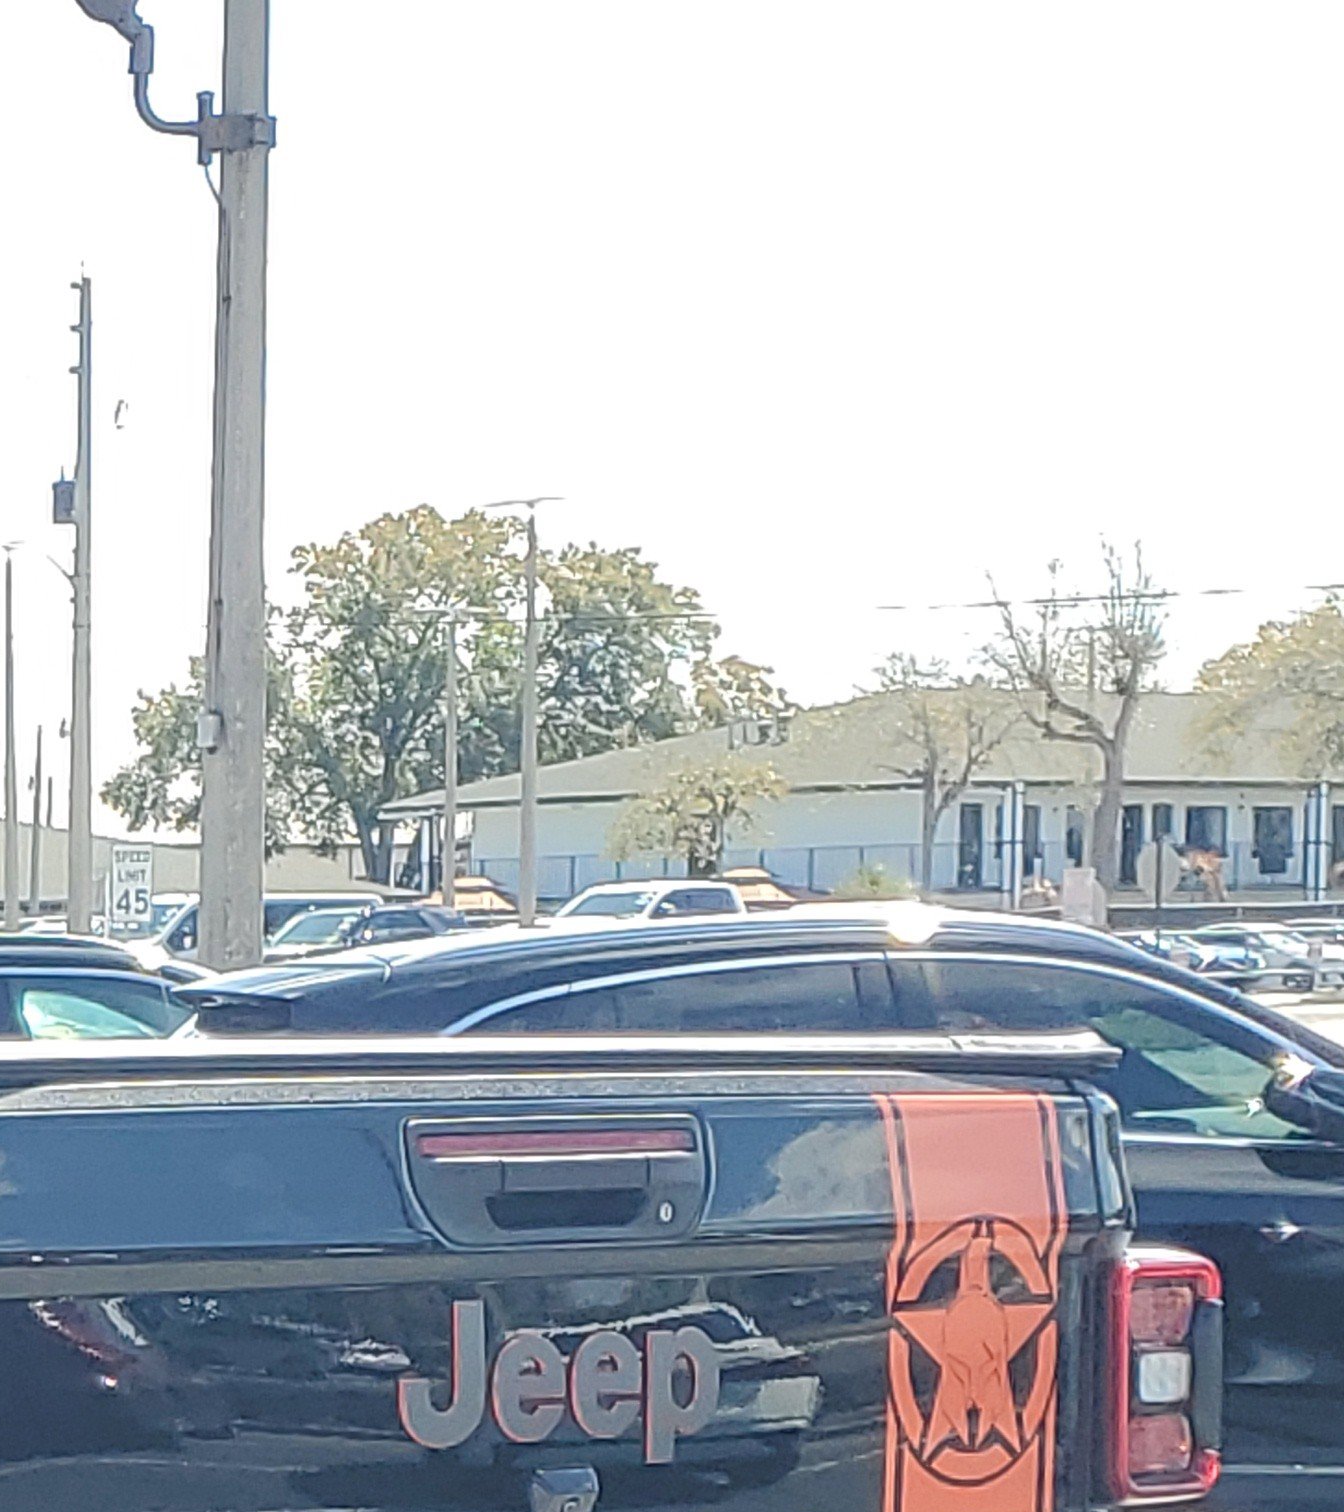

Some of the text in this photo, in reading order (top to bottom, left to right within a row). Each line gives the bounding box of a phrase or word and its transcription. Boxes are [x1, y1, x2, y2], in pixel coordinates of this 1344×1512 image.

[115, 850, 150, 862] SPEED
[118, 869, 146, 882] LIMIT
[116, 888, 149, 914] 45
[398, 1299, 720, 1465] Jeep
